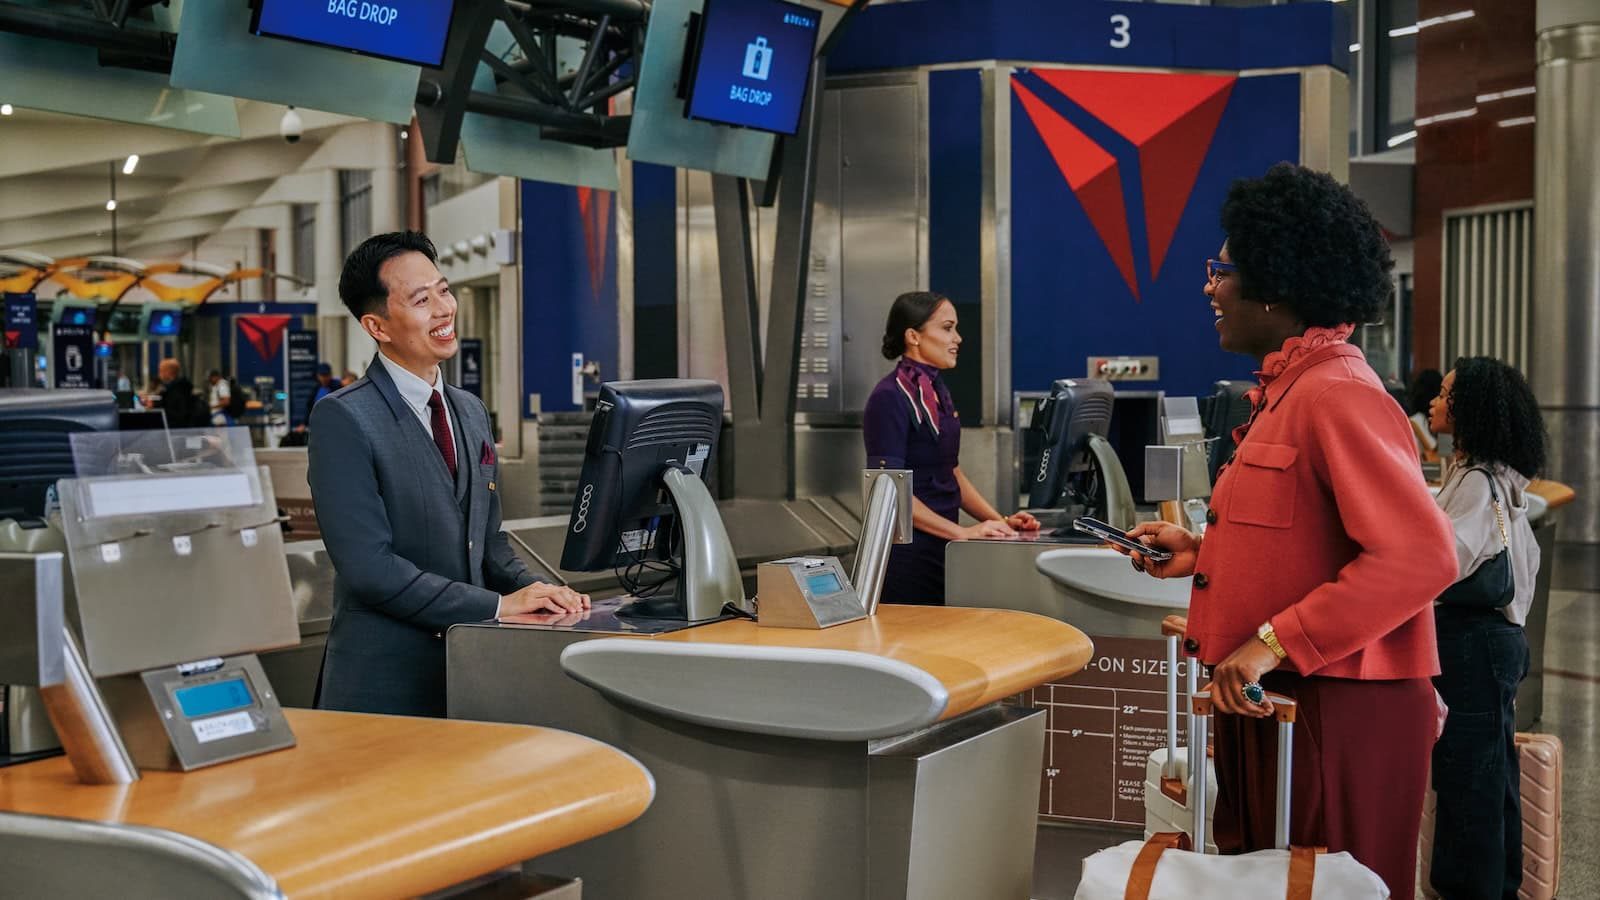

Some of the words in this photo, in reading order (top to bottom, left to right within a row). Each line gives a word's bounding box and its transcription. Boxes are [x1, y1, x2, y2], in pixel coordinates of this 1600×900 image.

[327, 0, 358, 18] BAG
[359, 2, 398, 26] DROP
[1110, 14, 1131, 48] 3
[730, 84, 749, 103] BAG
[748, 88, 772, 106] DROP
[1131, 658, 1169, 676] SIZE
